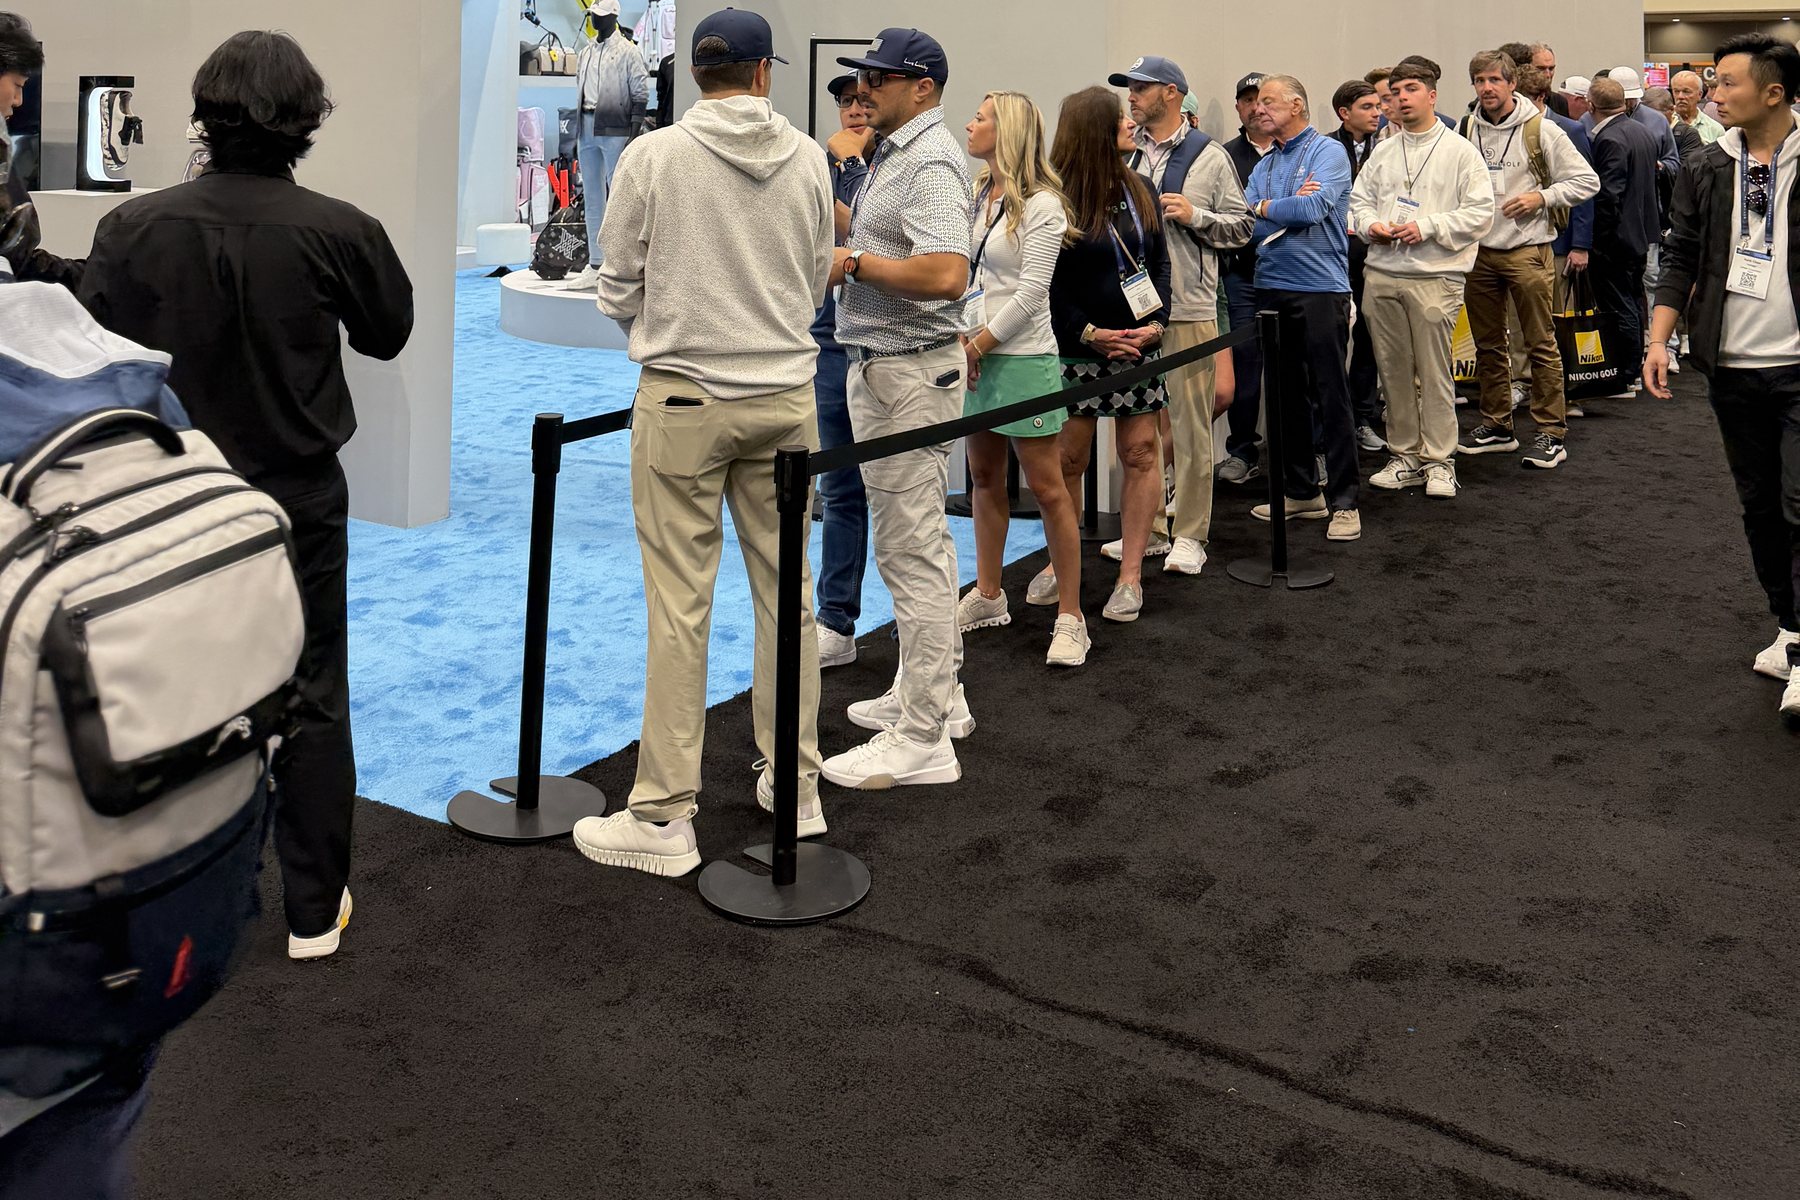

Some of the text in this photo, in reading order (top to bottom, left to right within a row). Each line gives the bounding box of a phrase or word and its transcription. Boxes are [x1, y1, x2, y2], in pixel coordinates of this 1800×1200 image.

[1580, 353, 1604, 364] Nikon
[1568, 367, 1619, 382] NIKON GOLF
